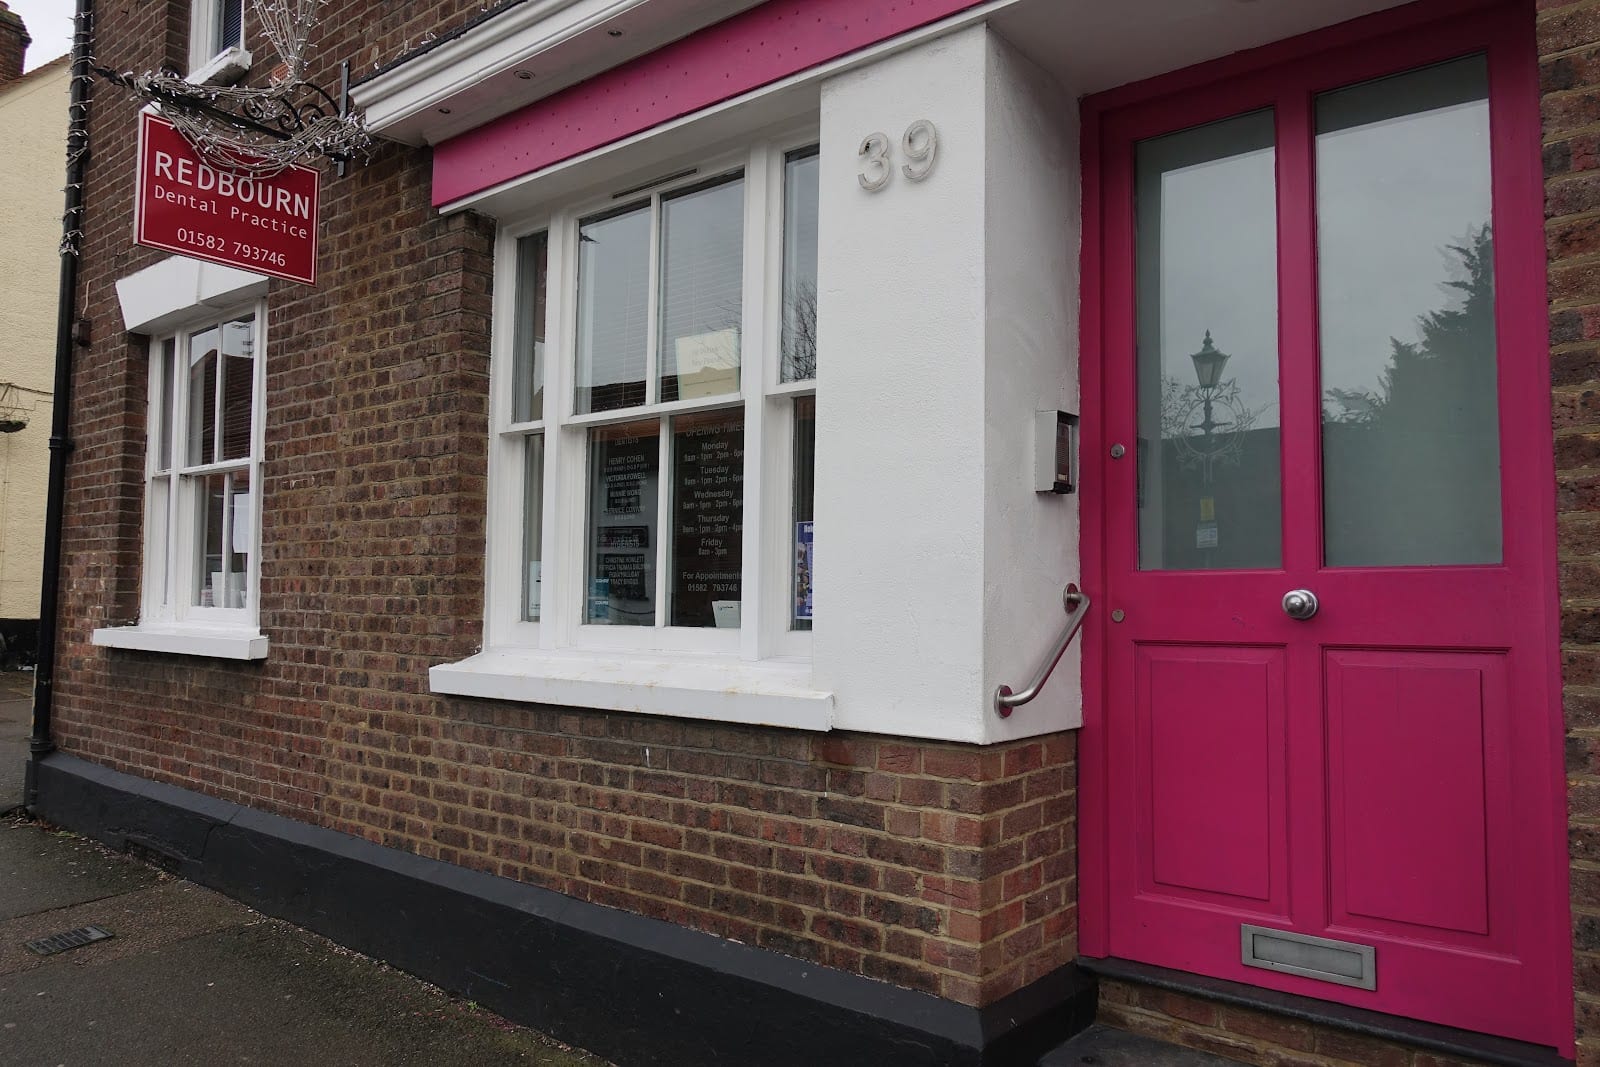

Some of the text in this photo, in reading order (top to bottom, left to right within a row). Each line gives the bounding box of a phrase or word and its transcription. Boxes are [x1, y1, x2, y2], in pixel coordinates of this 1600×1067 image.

[858, 120, 937, 191] 39
[155, 150, 309, 220] REDBOURN
[155, 185, 307, 239] Dental Practice
[177, 228, 286, 267] 01582 793746
[686, 424, 720, 437] OPENING
[702, 441, 728, 451] Monday
[700, 466, 729, 474] Tuesday
[694, 490, 734, 499] Wednesday
[698, 514, 729, 523] Thursday
[701, 537, 722, 547] Friday
